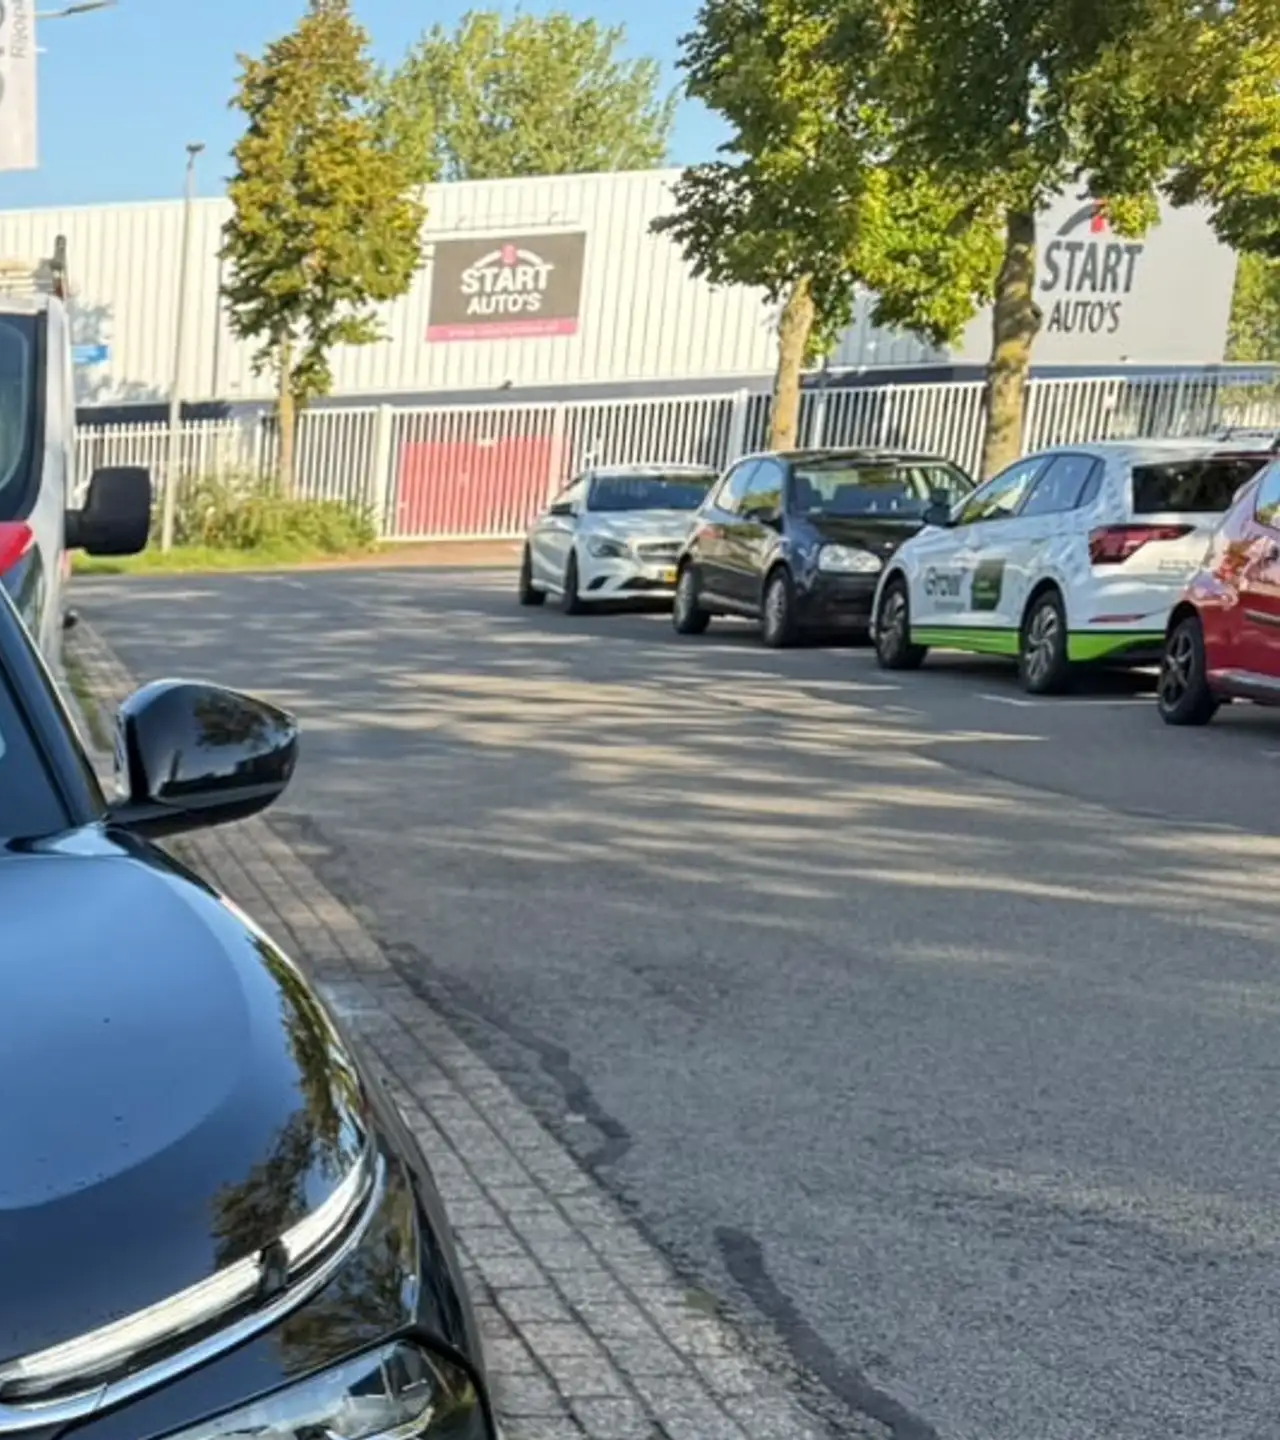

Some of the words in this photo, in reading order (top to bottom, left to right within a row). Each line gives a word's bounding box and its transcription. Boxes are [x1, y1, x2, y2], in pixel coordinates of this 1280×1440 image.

[460, 261, 555, 295] START
[1040, 240, 1144, 293] START
[466, 292, 542, 315] AUTO'S
[1047, 299, 1122, 334] AUTO'S
